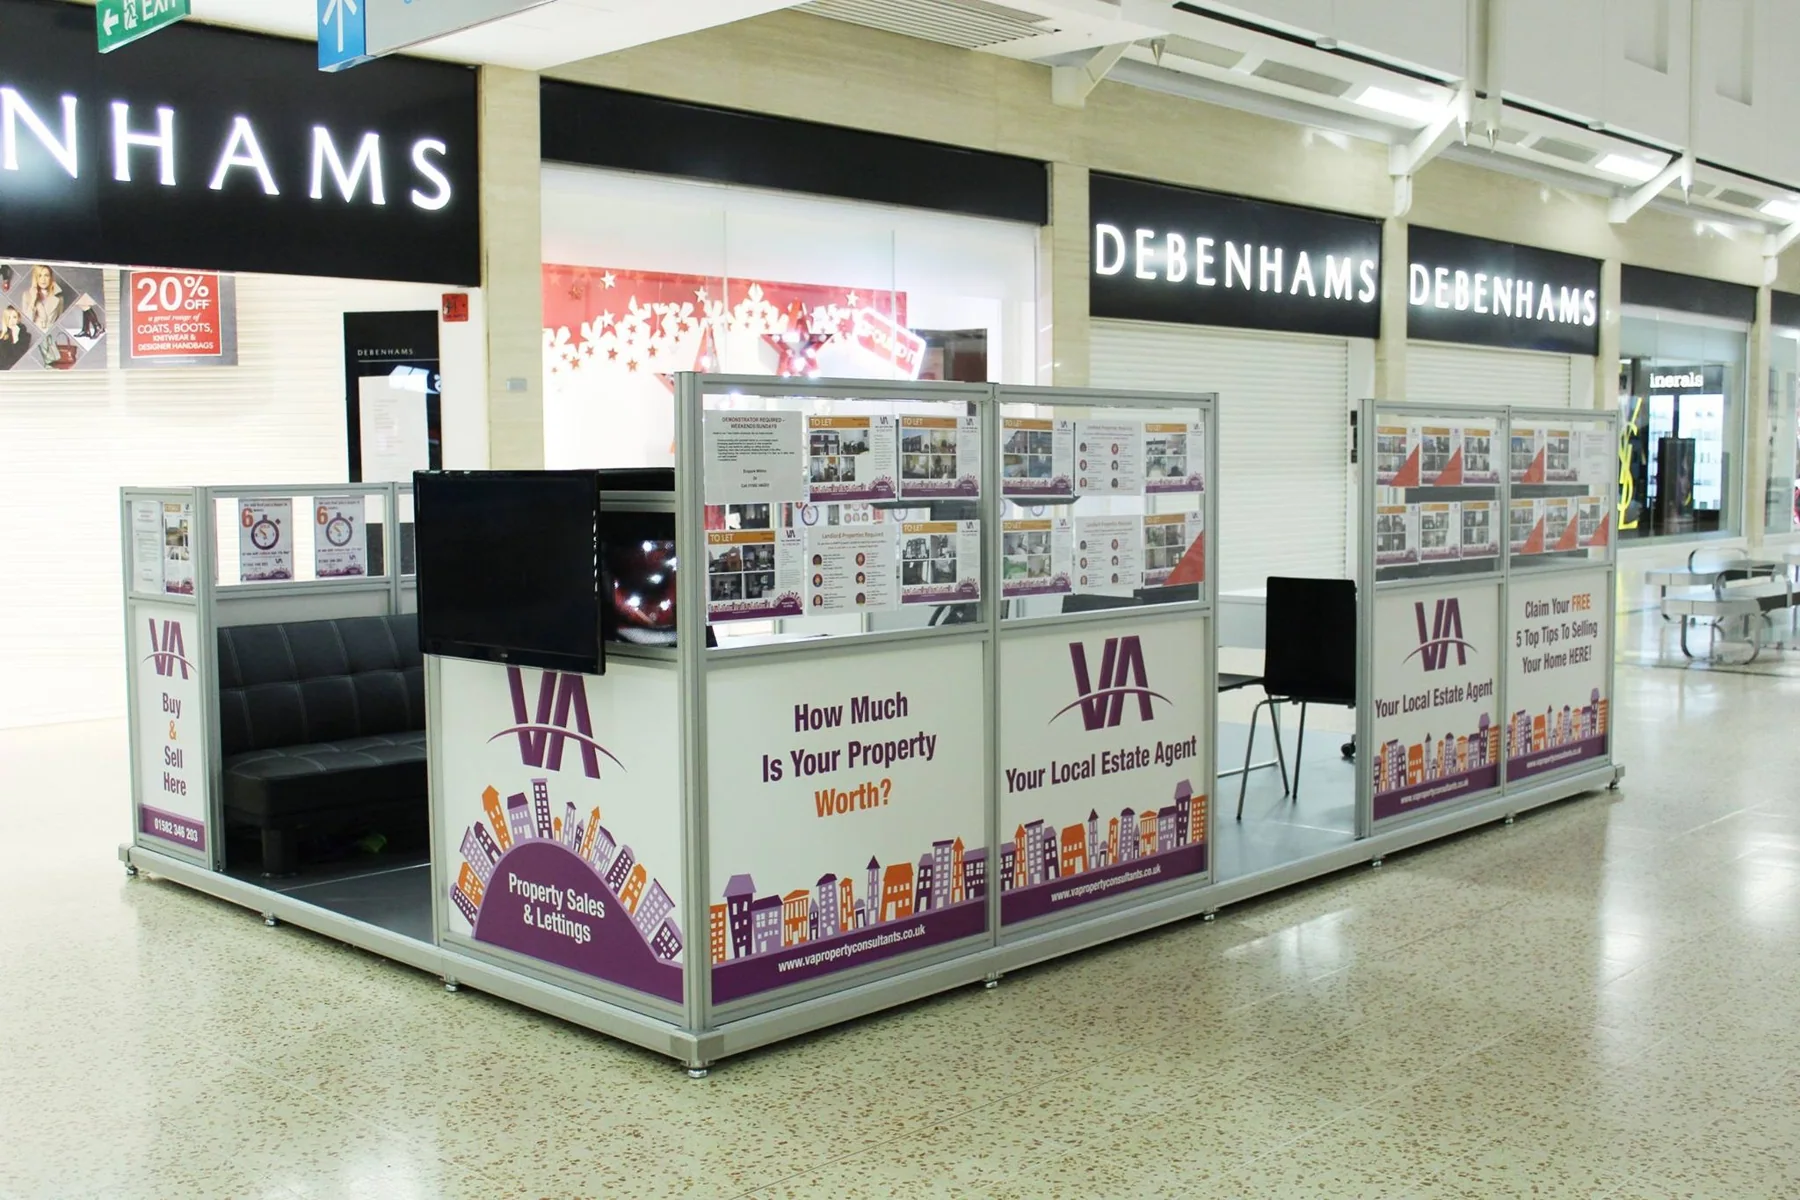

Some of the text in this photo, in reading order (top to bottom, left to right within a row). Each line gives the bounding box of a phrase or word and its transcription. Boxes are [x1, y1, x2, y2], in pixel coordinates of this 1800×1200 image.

[1095, 223, 1376, 303] DEBENHAMS
[137, 276, 211, 312] 20% OFF
[1409, 263, 1597, 326] DEBENHAMS
[138, 322, 213, 335] COATS, BOOTS,
[138, 341, 214, 351] DESIGNER HANDBAGS
[357, 348, 414, 356] DEBENHAMS
[811, 418, 832, 427] TO LET
[242, 508, 254, 528] 6
[317, 505, 328, 525] 6
[710, 534, 734, 542] TO LET
[1525, 593, 1591, 619] Claim Your FREE
[149, 618, 189, 680] VA
[1415, 598, 1466, 672] VA
[1516, 621, 1598, 649] 5 Top Tips To Selling
[1522, 645, 1592, 674] Your Home HERE!
[1069, 635, 1154, 731] VA
[1376, 678, 1493, 719] Your Local Estate Agent
[162, 692, 181, 719] Buy
[506, 664, 600, 779] VA
[794, 691, 908, 733] How Much
[169, 720, 177, 741] &
[164, 748, 183, 769] Sell
[762, 731, 937, 783] Is Your Property
[1006, 735, 1197, 793] Your Local Estate Agent
[164, 771, 187, 796] Here
[814, 778, 892, 818] Worth?
[154, 817, 173, 834] 01582
[174, 824, 186, 838] 346
[508, 872, 605, 920] Property Sales
[1051, 863, 1161, 902] www.vapropertyconsultants.co.uk
[523, 905, 591, 945] & Lettings
[778, 924, 925, 973] www.vapropertyconsultants.co.uk
